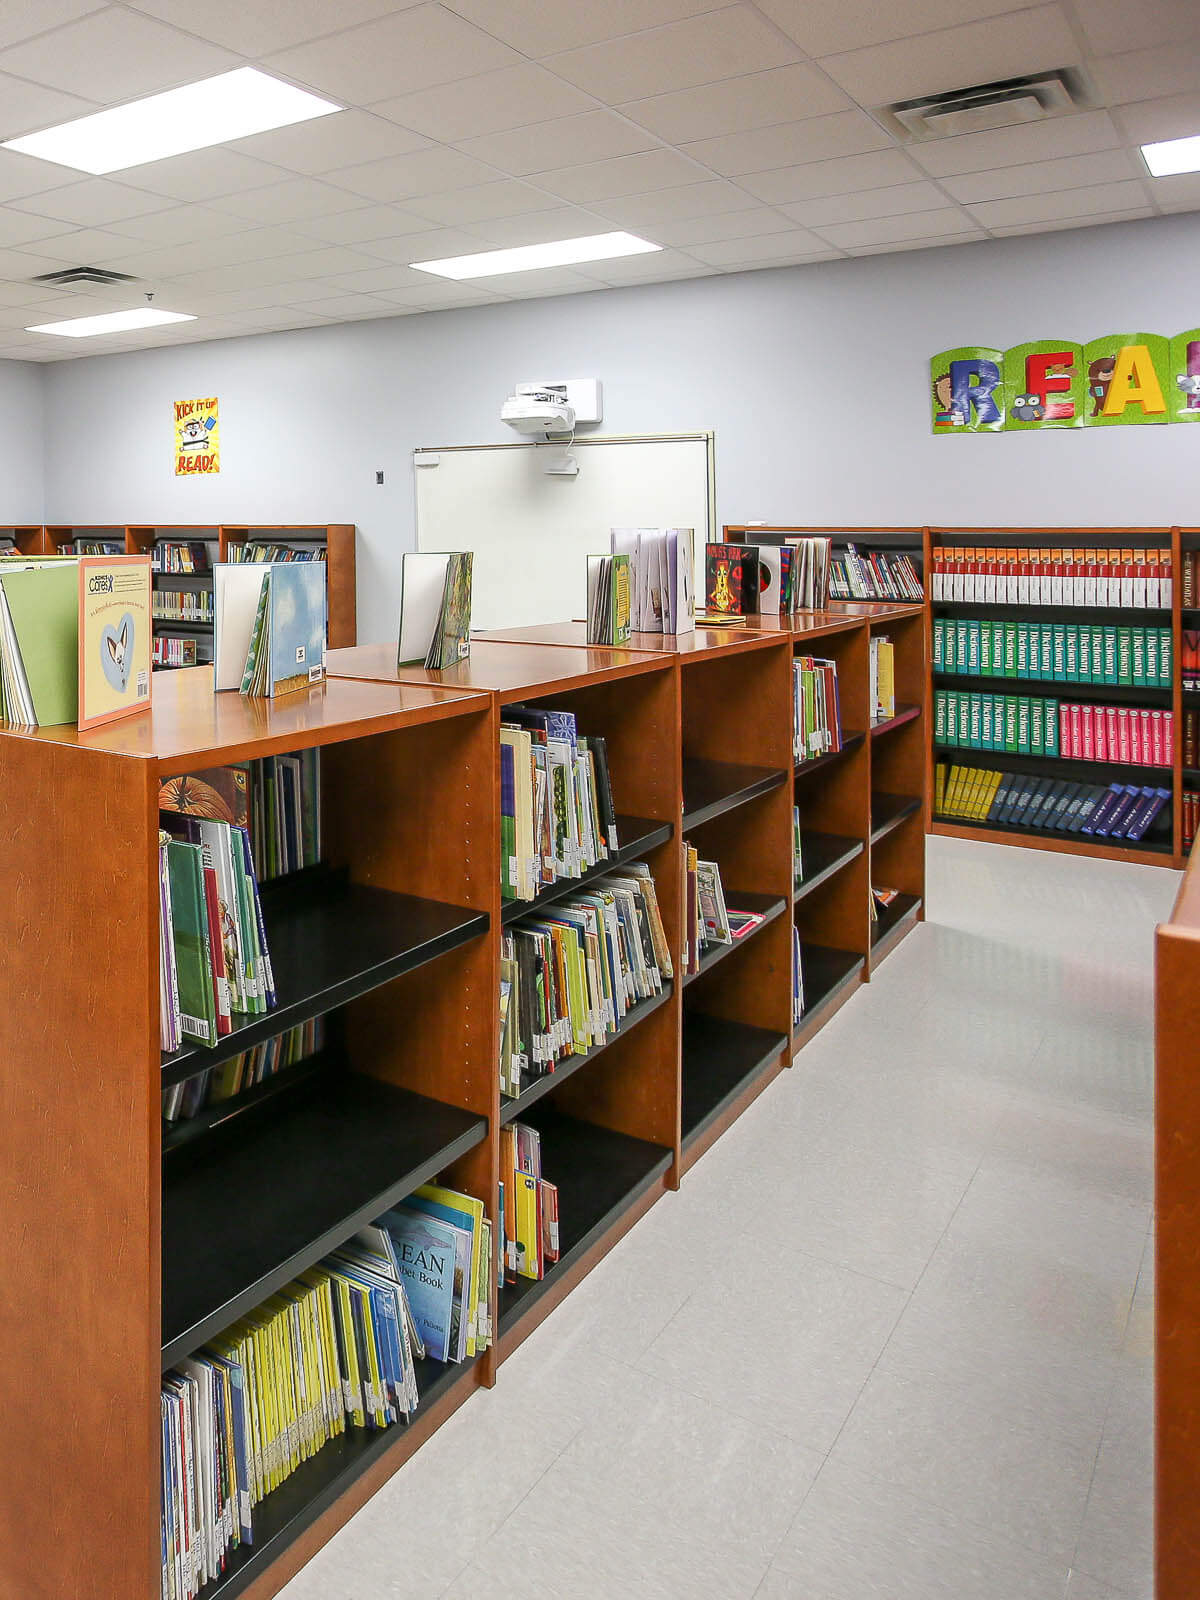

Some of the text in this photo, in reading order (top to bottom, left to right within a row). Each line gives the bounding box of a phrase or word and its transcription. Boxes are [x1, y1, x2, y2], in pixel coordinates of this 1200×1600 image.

[950, 341, 1200, 424] REA
[175, 400, 216, 421] KICK IT UP
[178, 453, 216, 472] READ!
[89, 578, 108, 592] Cares
[419, 1271, 444, 1291] Book
